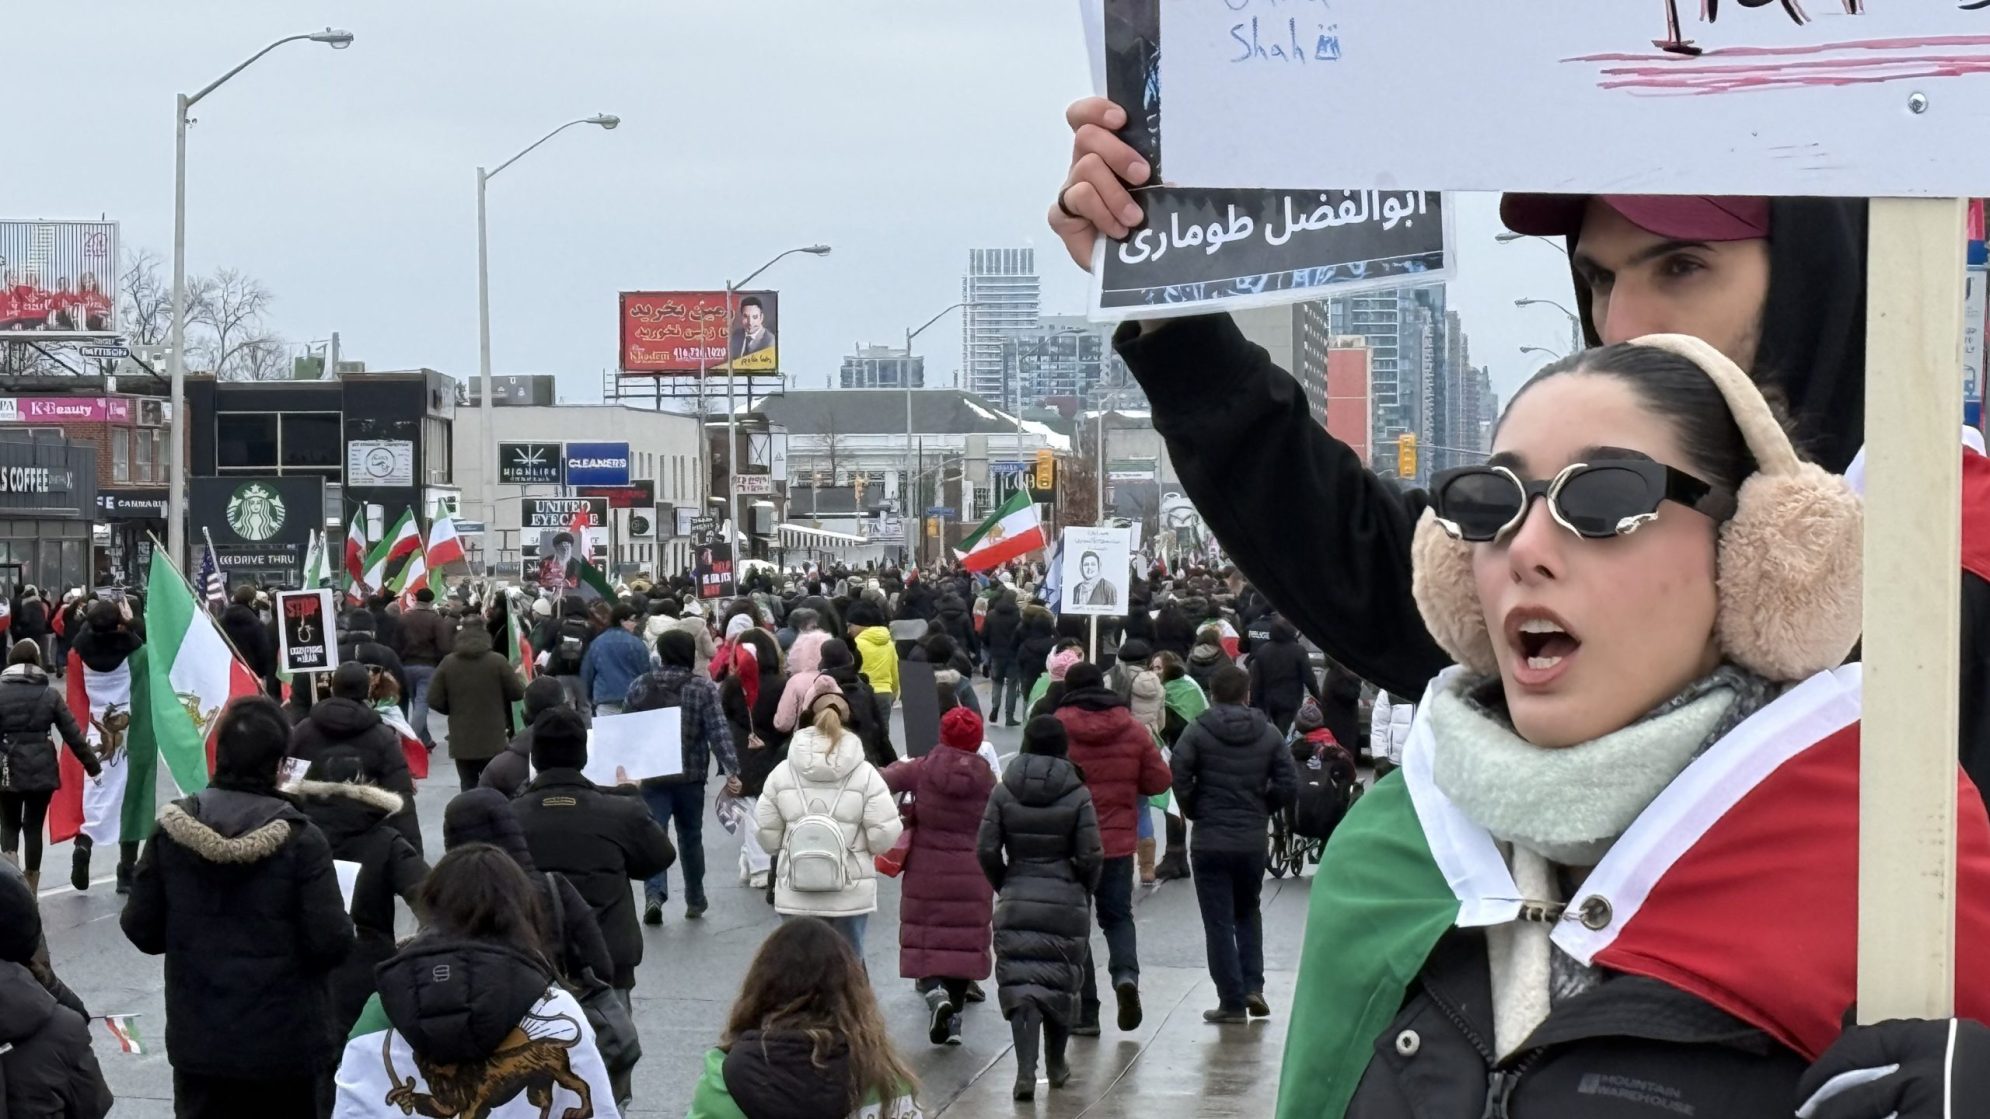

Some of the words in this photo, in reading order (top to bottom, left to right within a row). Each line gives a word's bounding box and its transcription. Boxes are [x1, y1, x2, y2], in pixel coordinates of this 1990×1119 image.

[1230, 15, 1305, 63] Shah
[1264, 189, 1427, 246] ابوالفضل
[1118, 204, 1255, 265] طوماری
[10, 466, 49, 493] COFFEE
[531, 513, 599, 526] EYECAE
[535, 500, 591, 513] UNITED
[233, 555, 265, 565] DRIVE
[268, 555, 295, 564] THRU
